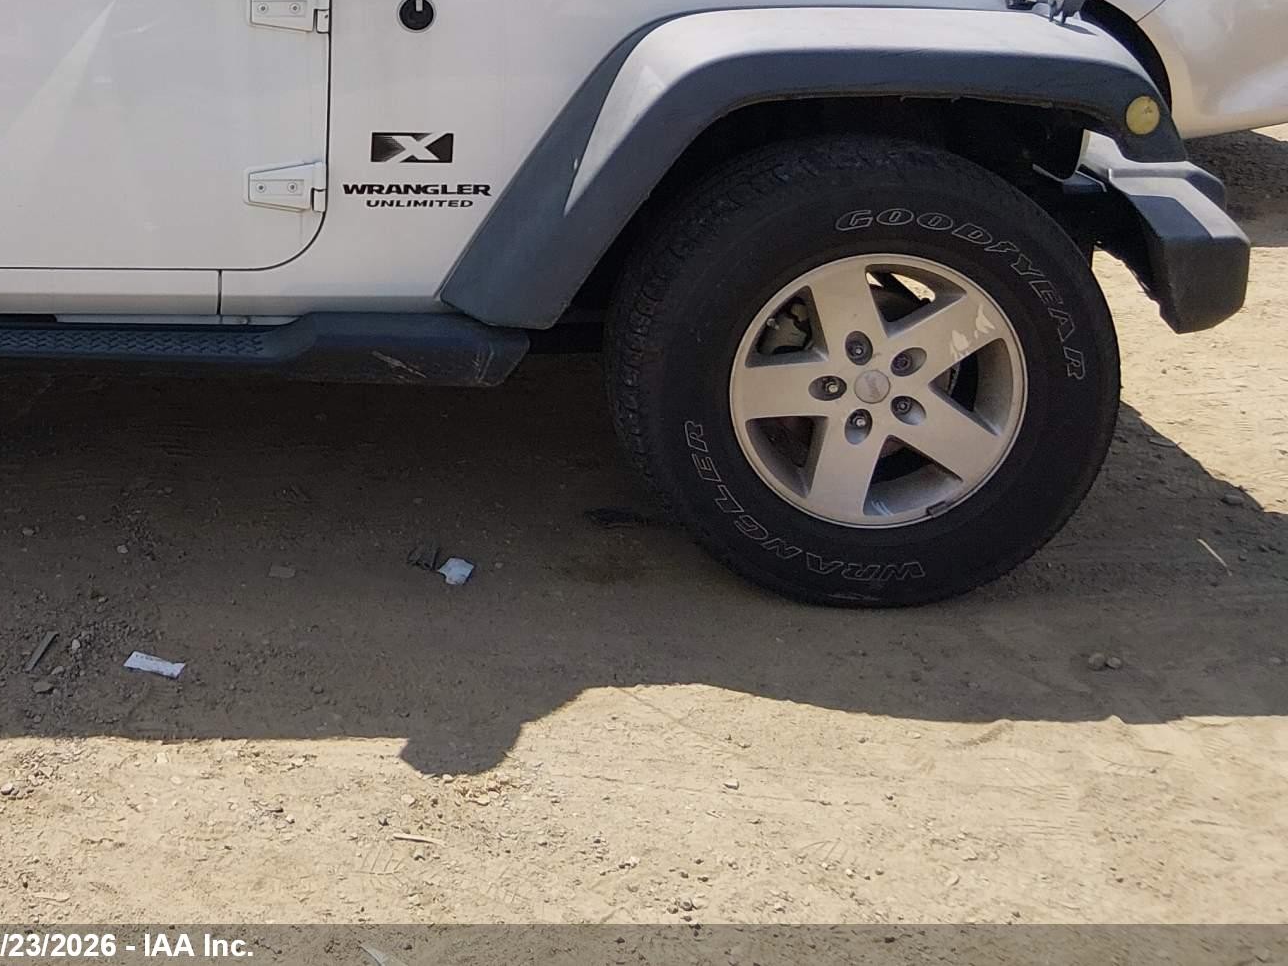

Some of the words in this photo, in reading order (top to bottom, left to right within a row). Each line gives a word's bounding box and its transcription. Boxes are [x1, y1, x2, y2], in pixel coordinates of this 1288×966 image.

[342, 183, 492, 197] WRANGLER
[366, 199, 474, 208] UNLIMITED
[834, 206, 1087, 381] GOODYEAR
[683, 419, 927, 583] WRANGLER
